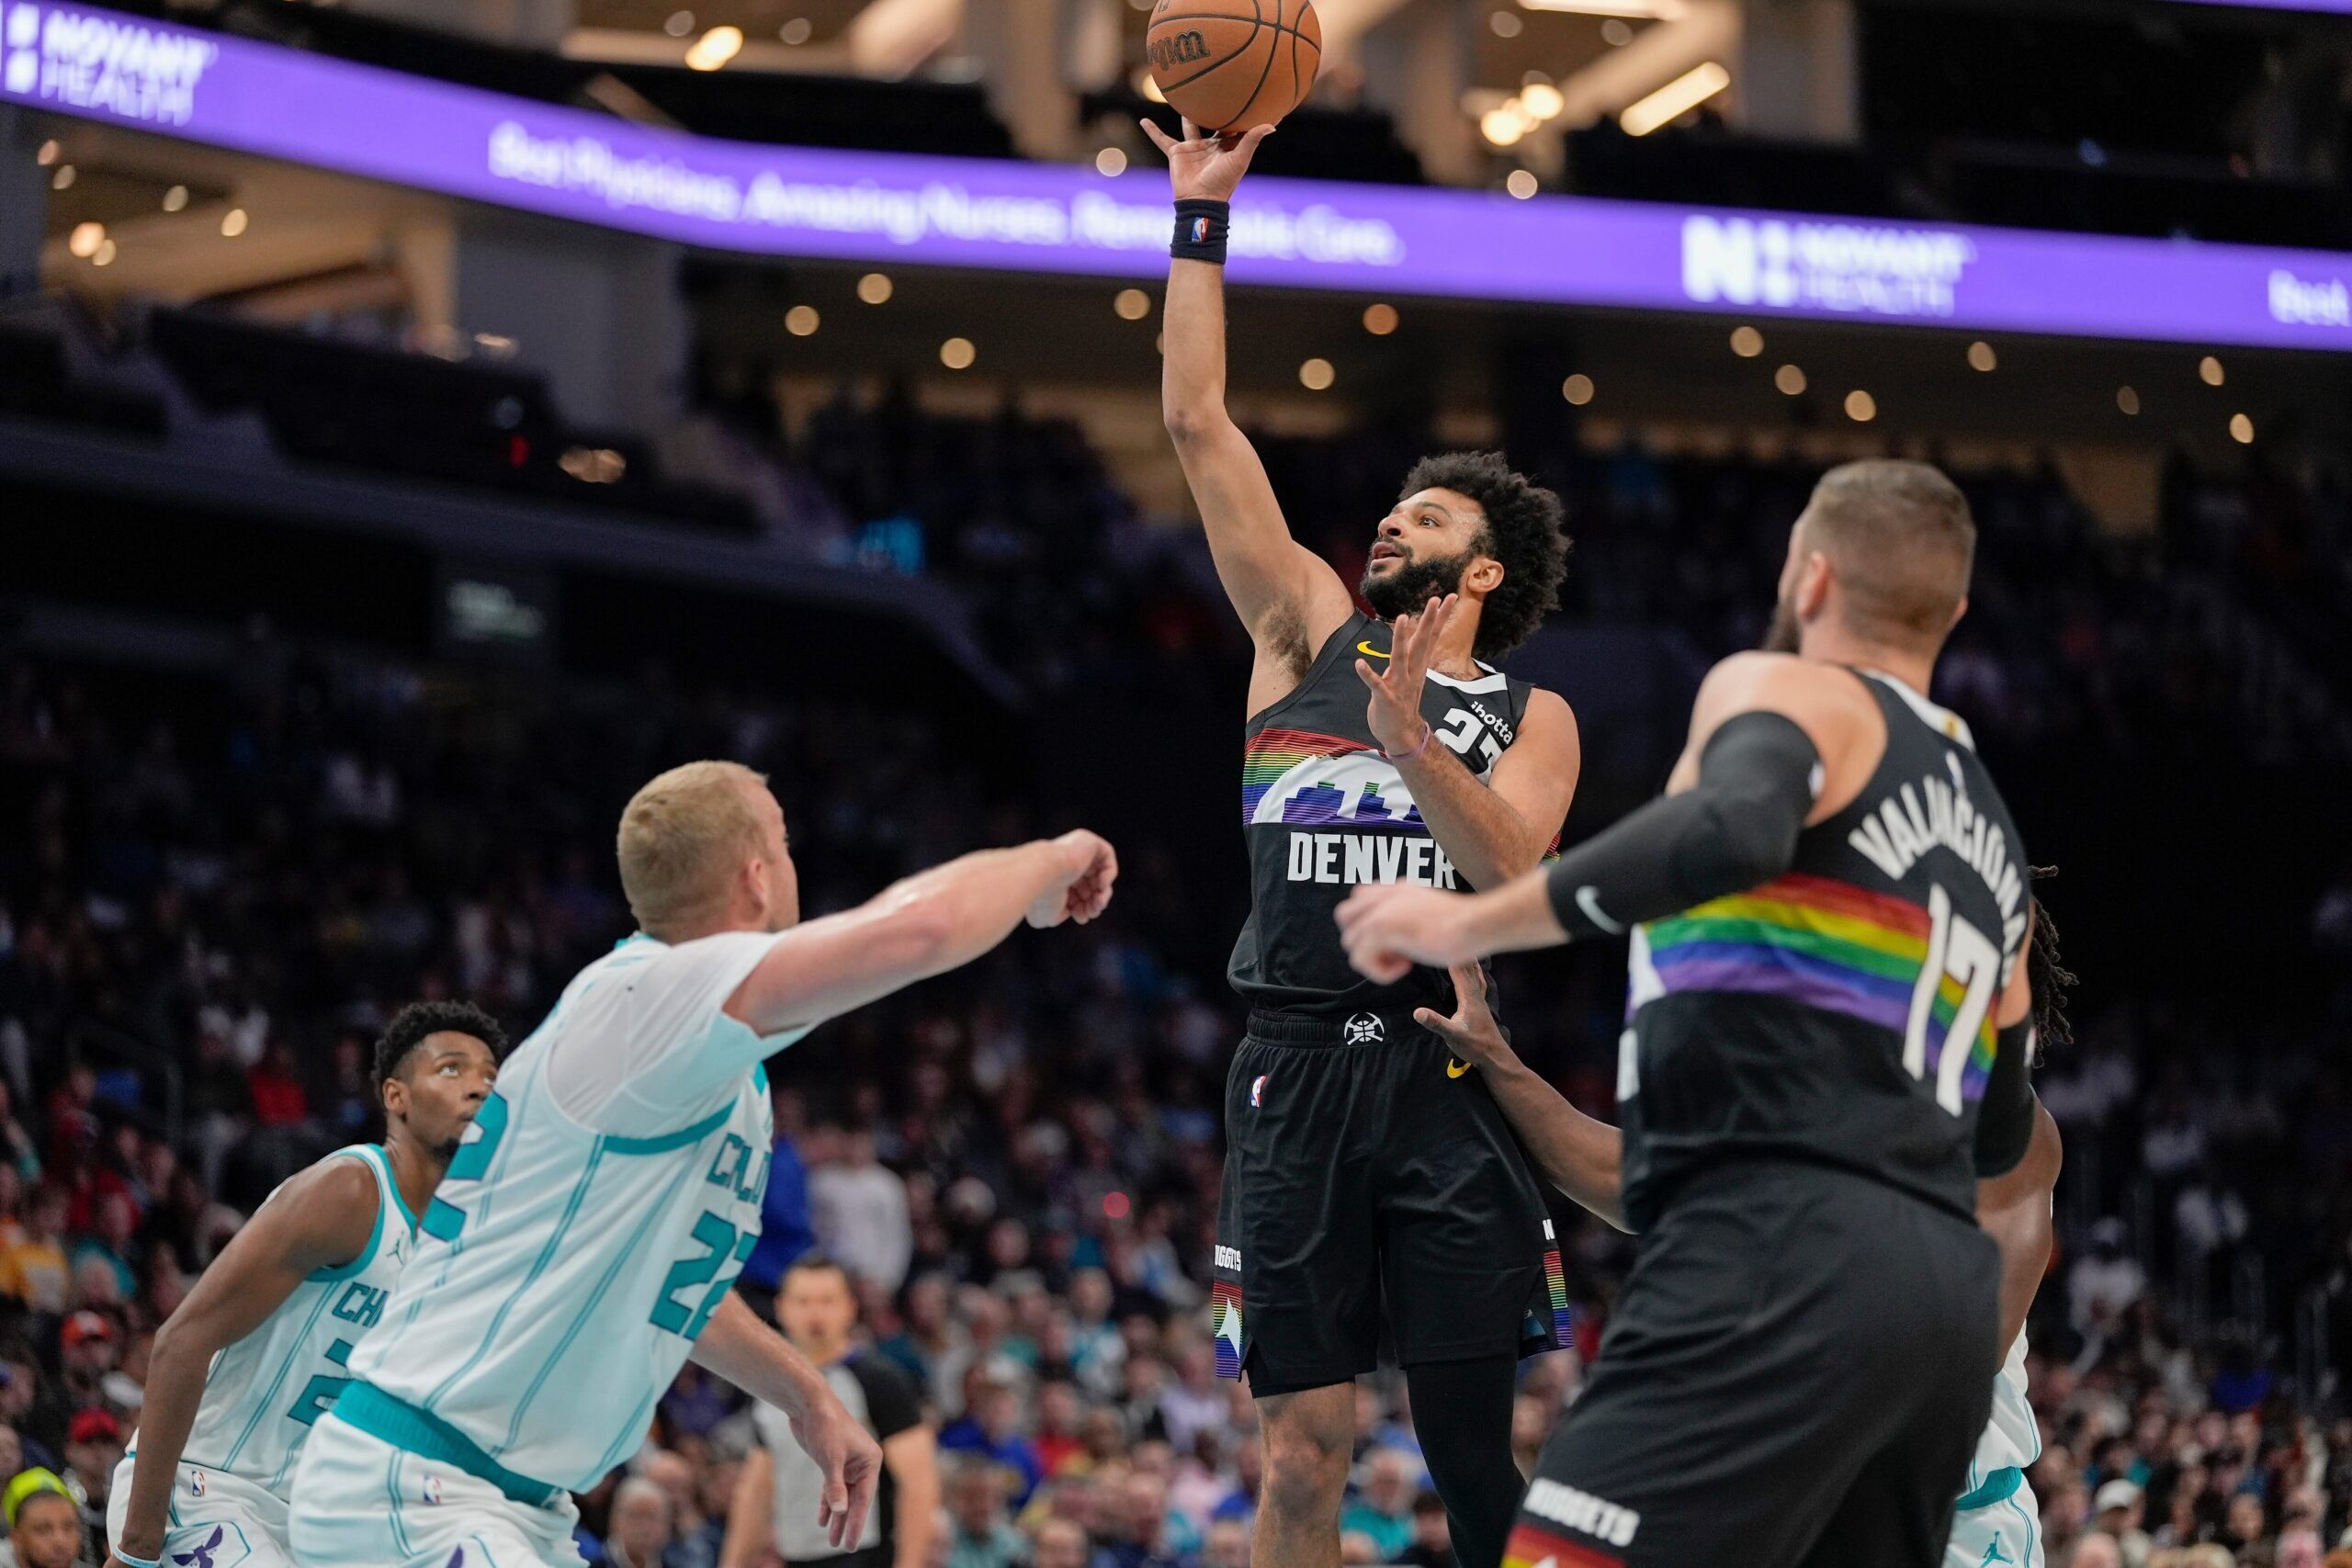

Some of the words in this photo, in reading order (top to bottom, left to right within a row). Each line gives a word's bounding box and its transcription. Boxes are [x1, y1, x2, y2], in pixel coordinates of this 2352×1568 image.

[40, 57, 195, 127] HEALTH
[1287, 832, 1456, 889] DENVER
[1903, 882, 2001, 1118] 17
